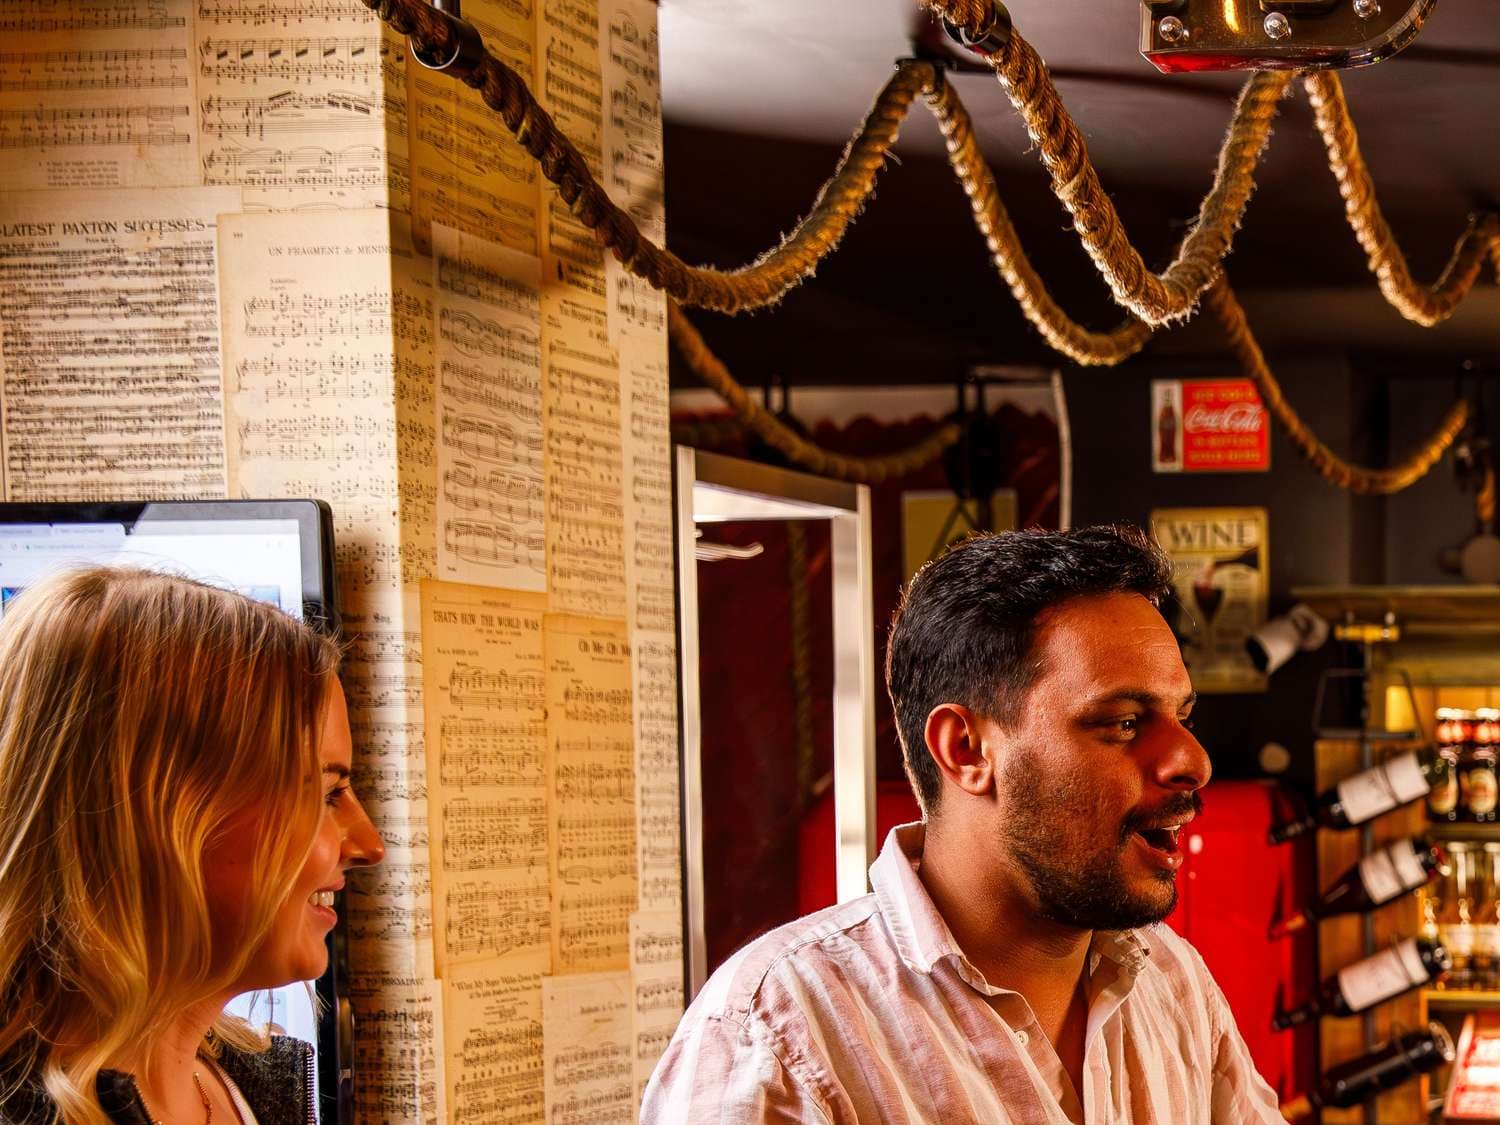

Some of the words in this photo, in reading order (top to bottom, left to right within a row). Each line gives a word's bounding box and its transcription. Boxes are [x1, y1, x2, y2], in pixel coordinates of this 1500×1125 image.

[3, 221, 56, 237] LATEST
[63, 220, 117, 236] PAXTON
[124, 218, 205, 234] SUCCESSES
